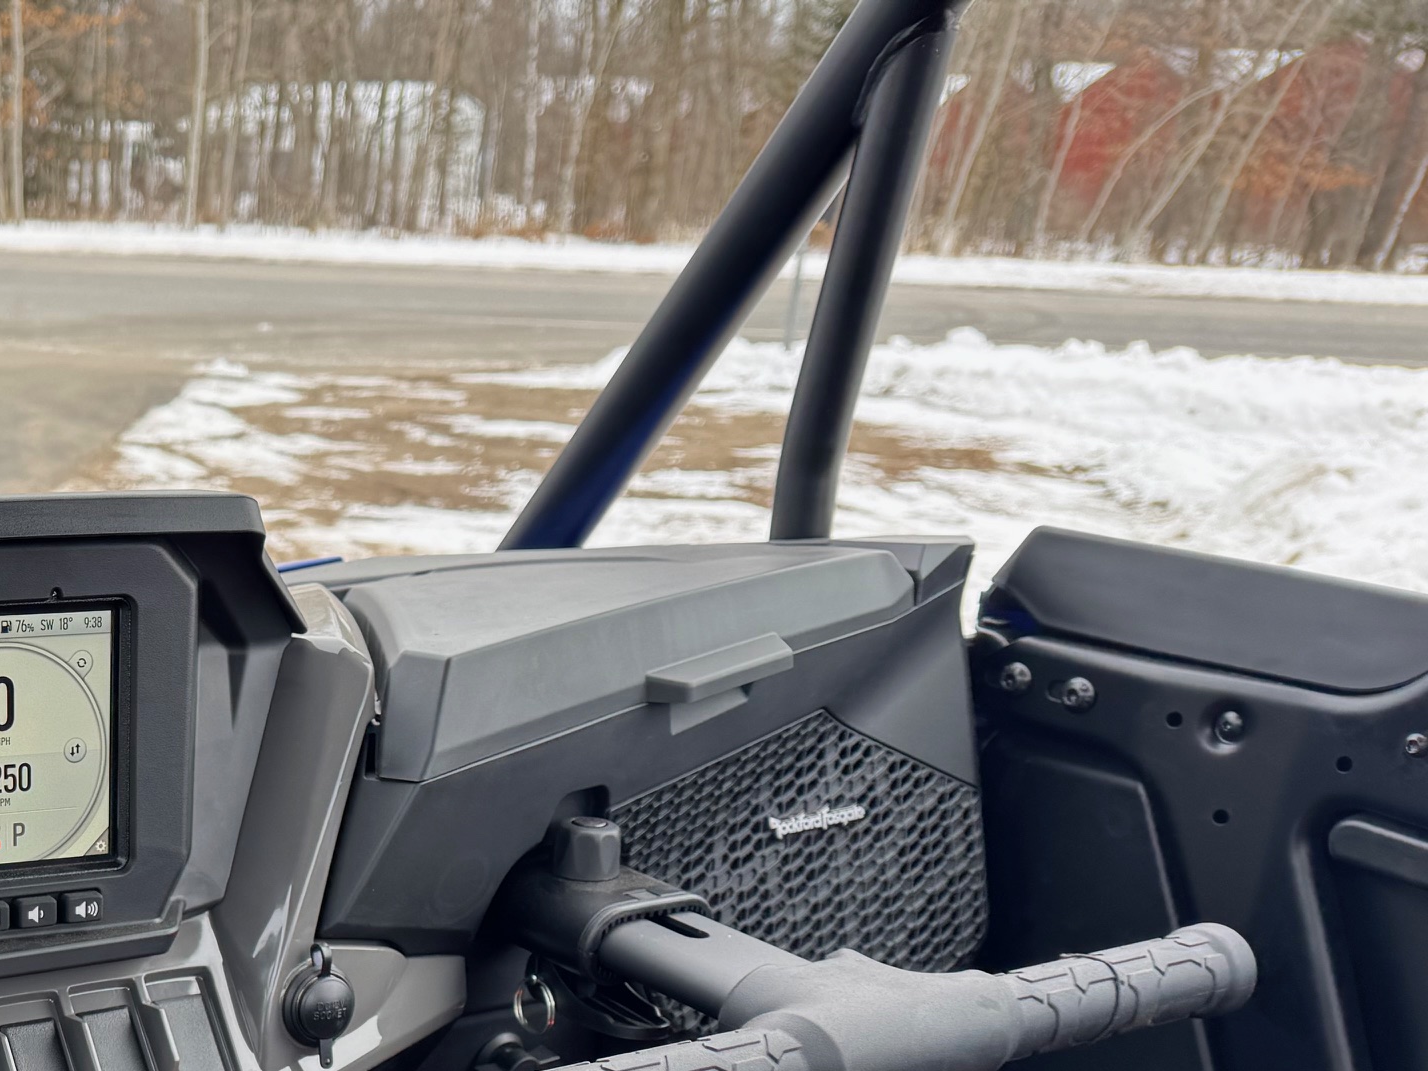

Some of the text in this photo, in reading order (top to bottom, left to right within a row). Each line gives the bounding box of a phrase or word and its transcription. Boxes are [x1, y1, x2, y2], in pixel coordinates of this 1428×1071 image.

[15, 616, 103, 633] 76% SW 18° 9:38
[12, 822, 25, 847] P
